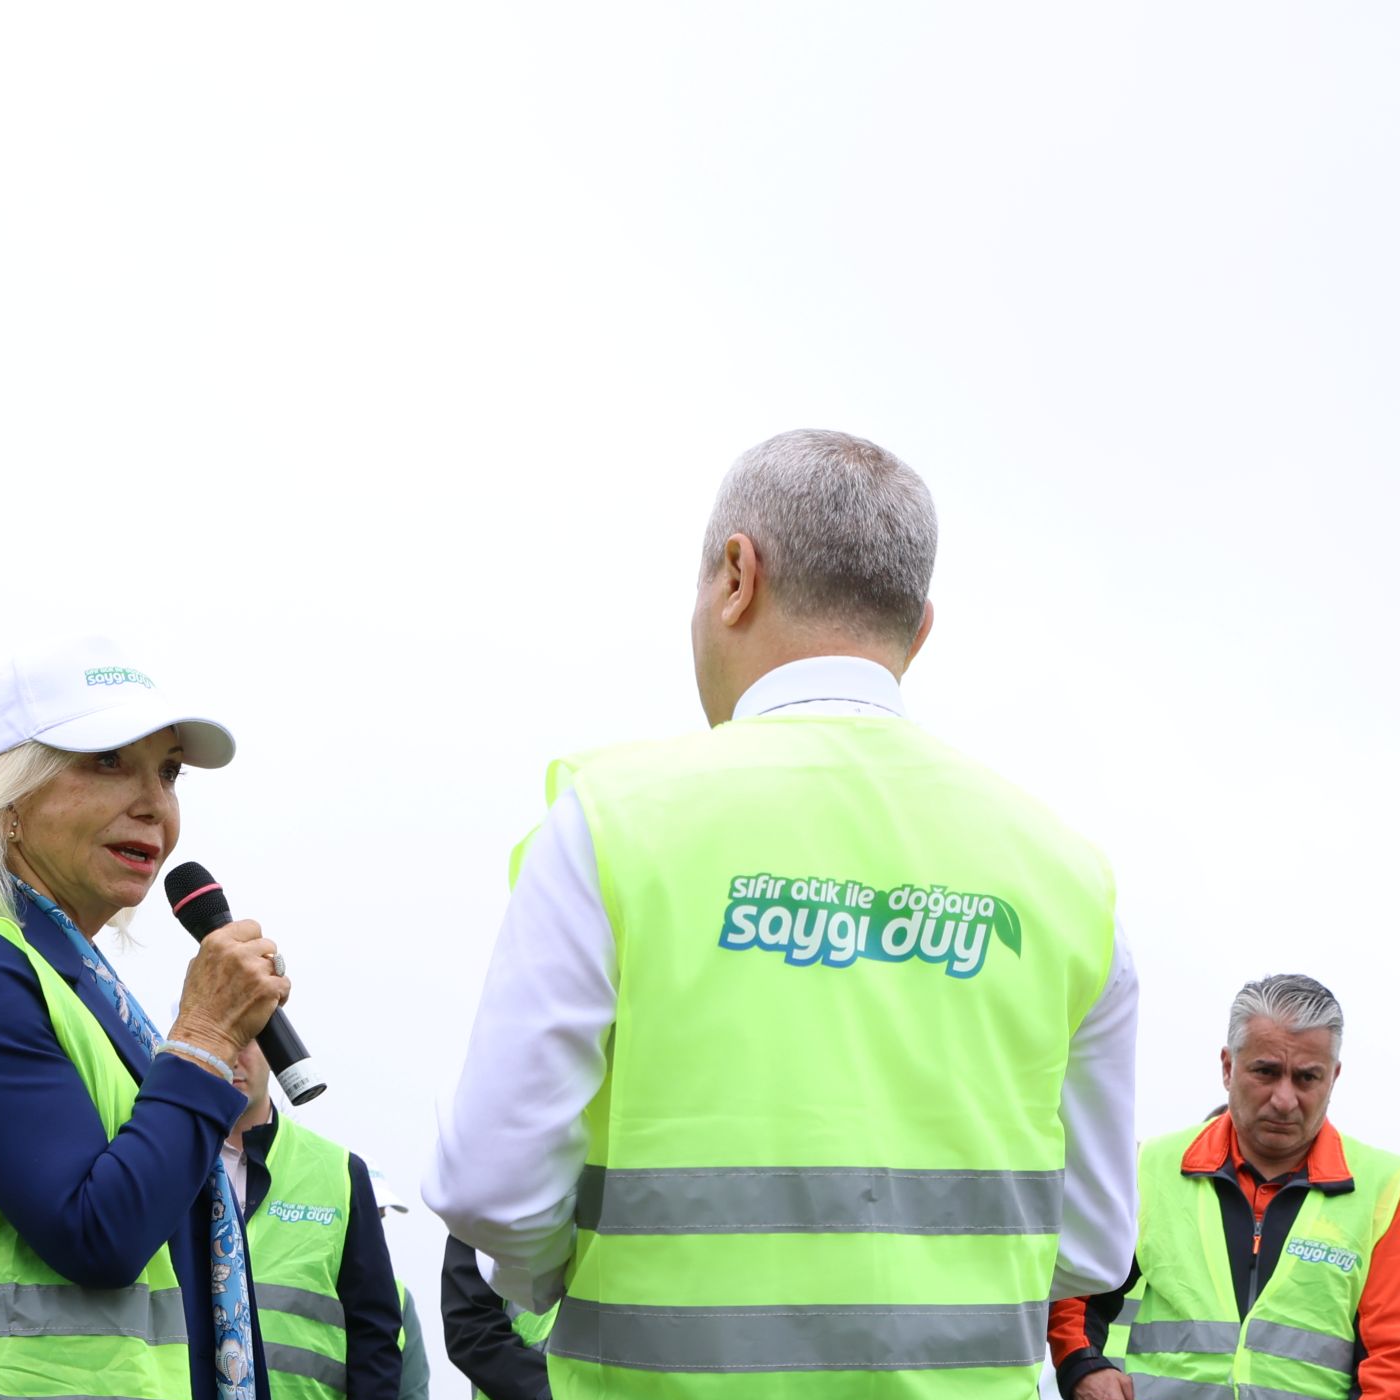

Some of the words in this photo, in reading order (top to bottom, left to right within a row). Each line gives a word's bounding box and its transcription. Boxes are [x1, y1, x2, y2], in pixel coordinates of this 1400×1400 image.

[732, 874, 786, 899] sıfır
[790, 879, 841, 905] atık
[844, 882, 875, 909] ile
[887, 885, 995, 921] doğaya
[726, 904, 870, 962] saygı
[880, 910, 987, 972] duy
[268, 1205, 304, 1222] saygı
[1287, 1243, 1327, 1262] saygı
